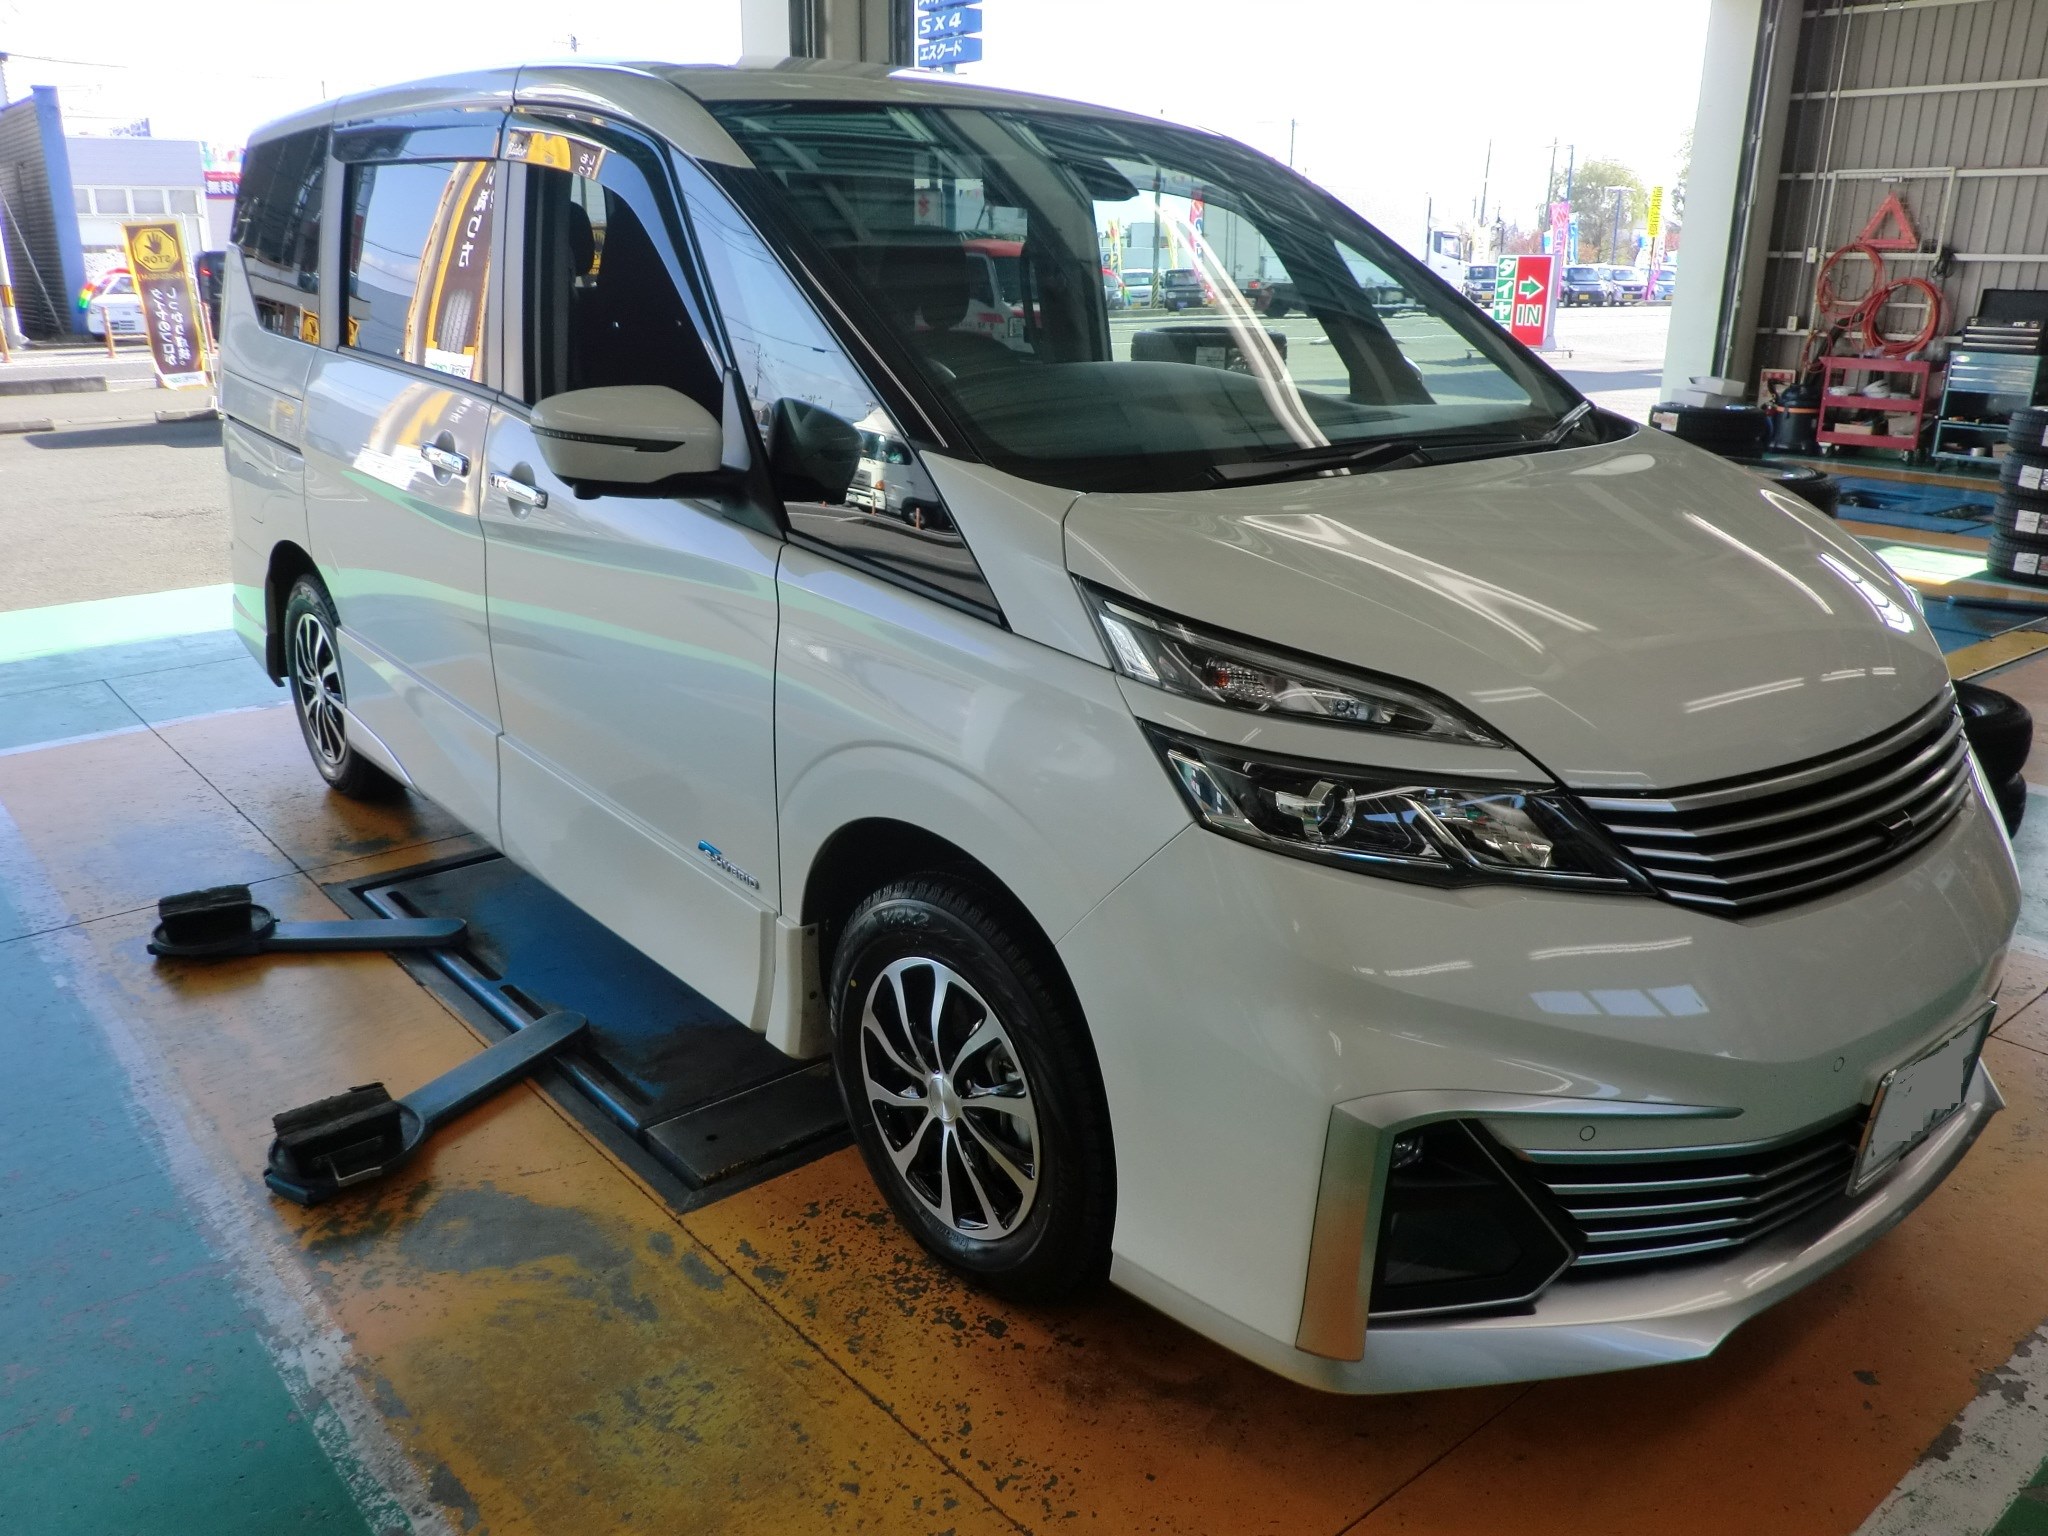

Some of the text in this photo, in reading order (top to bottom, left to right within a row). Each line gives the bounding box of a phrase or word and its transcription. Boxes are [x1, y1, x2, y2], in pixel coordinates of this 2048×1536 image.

[919, 39, 963, 61] エスクード
[1494, 258, 1516, 330] タイヤ
[1515, 303, 1542, 327] IN
